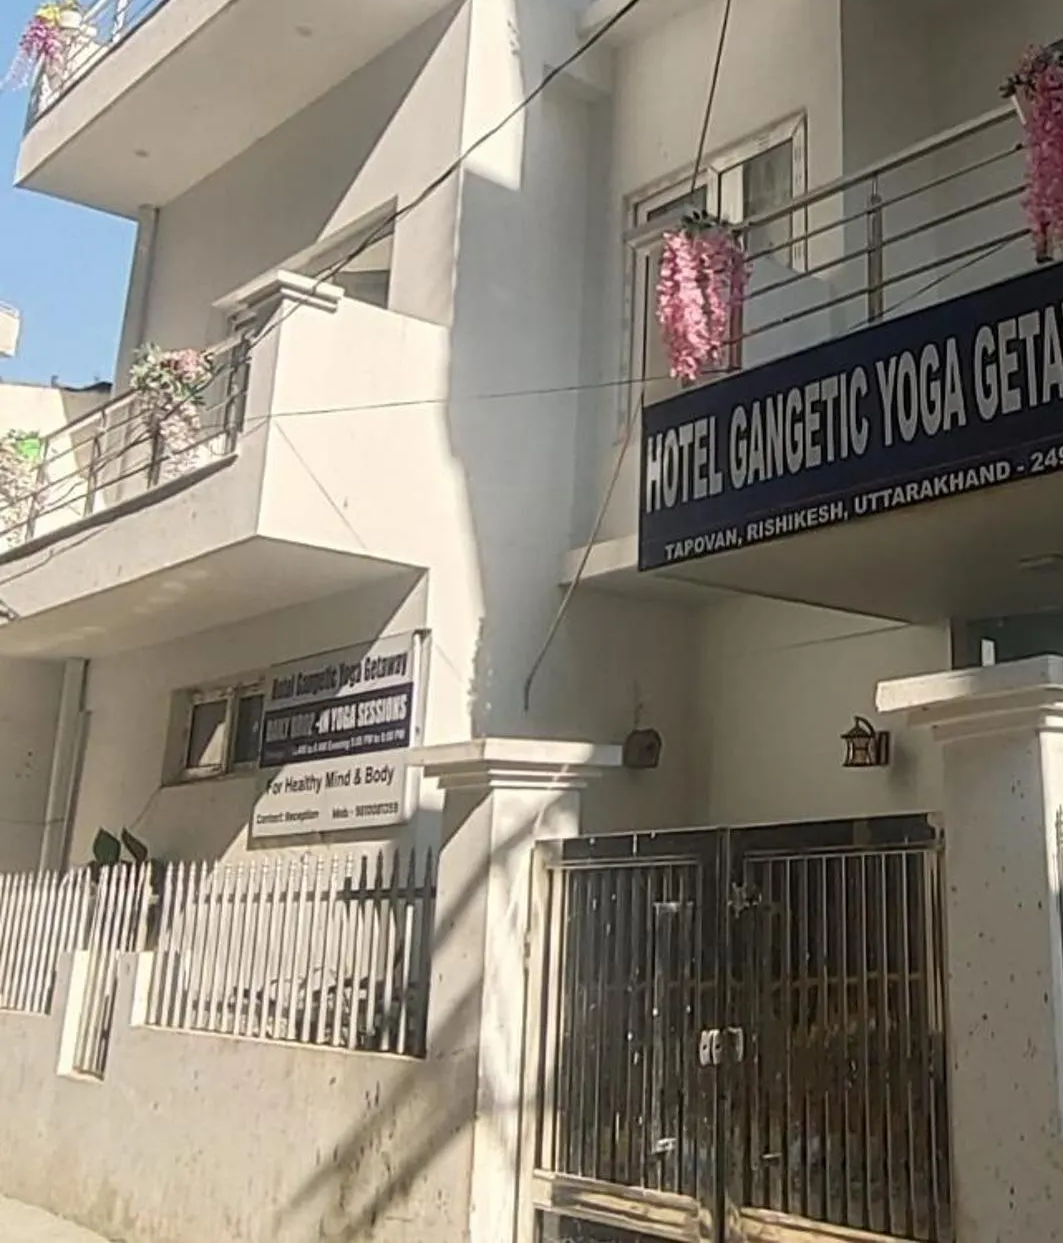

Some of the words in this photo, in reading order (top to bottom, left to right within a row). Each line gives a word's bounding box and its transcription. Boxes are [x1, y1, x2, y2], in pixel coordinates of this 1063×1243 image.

[646, 415, 723, 513] HOTEL
[729, 365, 869, 490] GANGETIC
[874, 337, 966, 445] YOGA
[664, 527, 743, 560] TAPOVAN,
[746, 499, 849, 543] RISHIKESH,
[853, 460, 1010, 515] UTTARAKHAND
[364, 653, 408, 681] Getaway
[331, 704, 356, 732] YOGA
[357, 694, 408, 728] SESSIONS
[285, 771, 323, 794] Healthy
[325, 768, 351, 788] Mind
[353, 768, 361, 785] &
[365, 764, 395, 785] Body
